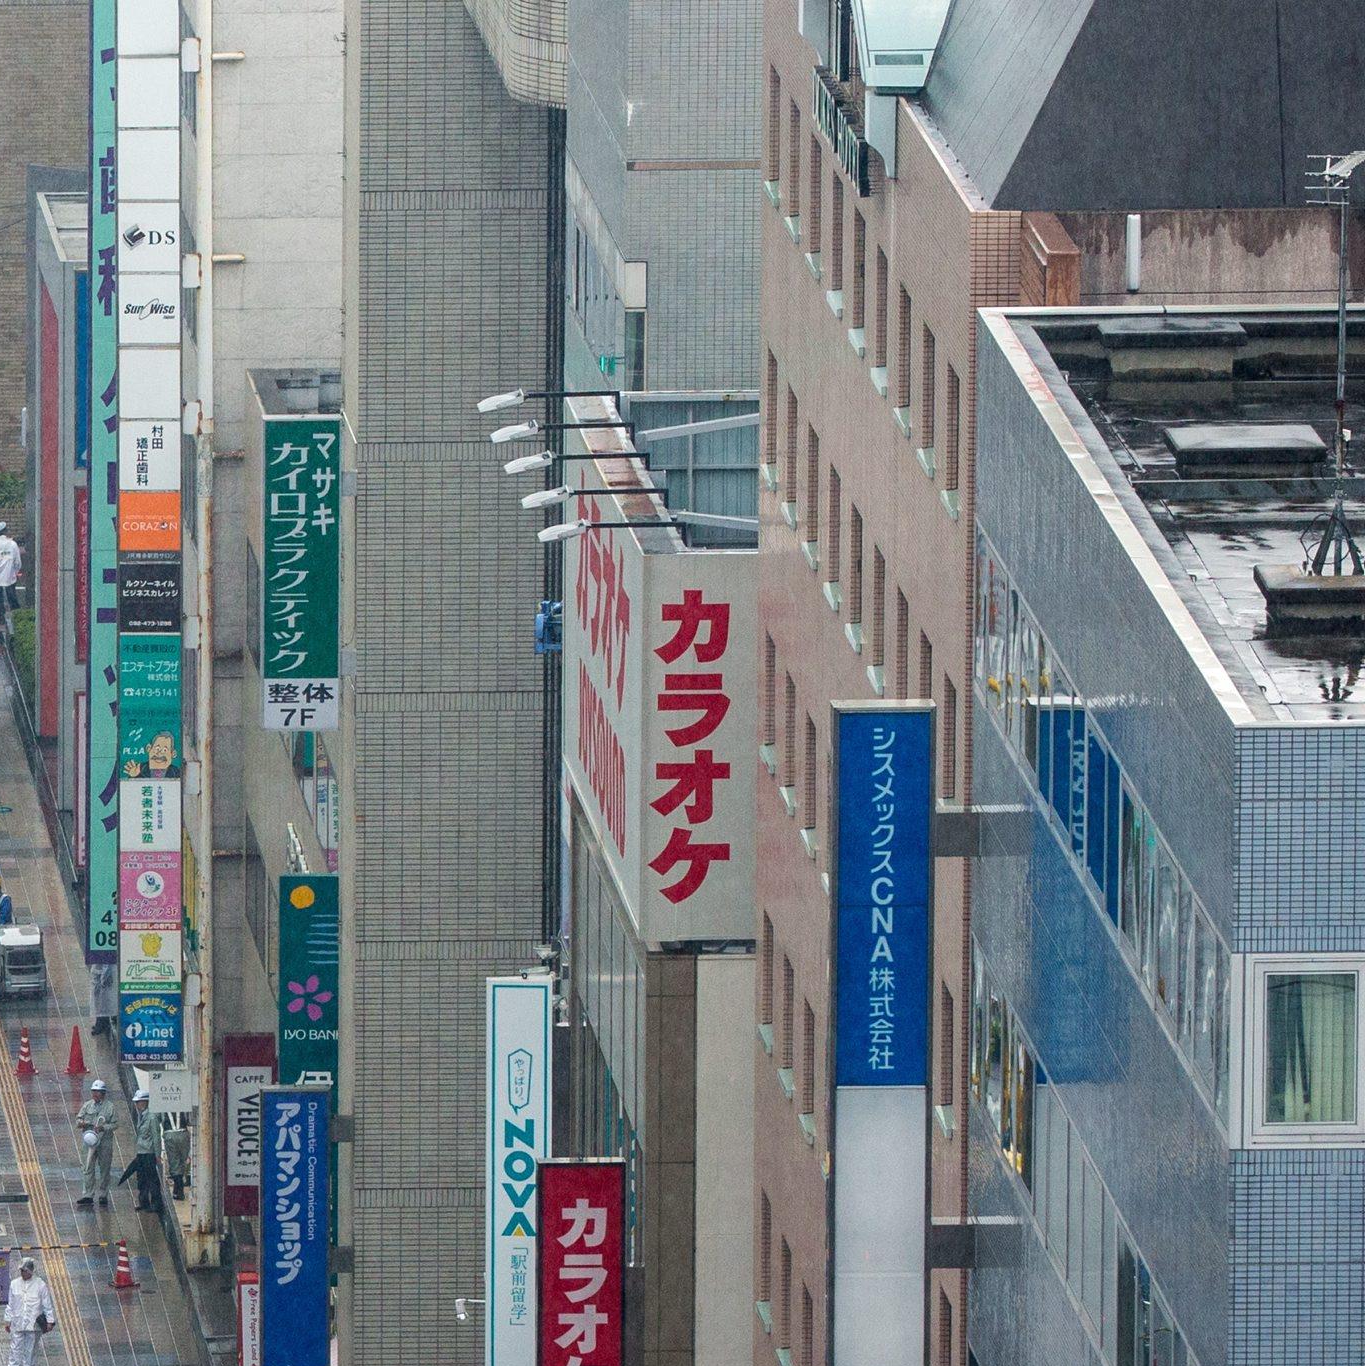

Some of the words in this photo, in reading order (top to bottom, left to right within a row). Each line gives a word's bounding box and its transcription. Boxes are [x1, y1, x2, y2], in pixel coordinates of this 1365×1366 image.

[124, 303, 144, 314] Sun
[149, 303, 176, 314] Wise
[136, 437, 149, 486] 矯正歯科
[152, 425, 163, 450] 村田
[312, 433, 336, 535] マサキ
[269, 442, 310, 673] カイロプラクティック
[268, 683, 335, 704] 整体
[280, 708, 316, 726] 7F
[648, 590, 731, 904] カラオケ
[868, 727, 896, 1070] シスメックスCNA株式会社
[284, 1029, 306, 1040] IYO
[309, 1029, 338, 1040] BAN
[307, 1102, 318, 1153] Dramatic
[275, 1102, 303, 1284] アパマンショップ
[307, 1156, 318, 1240] Communication
[503, 1119, 536, 1237] NOVA
